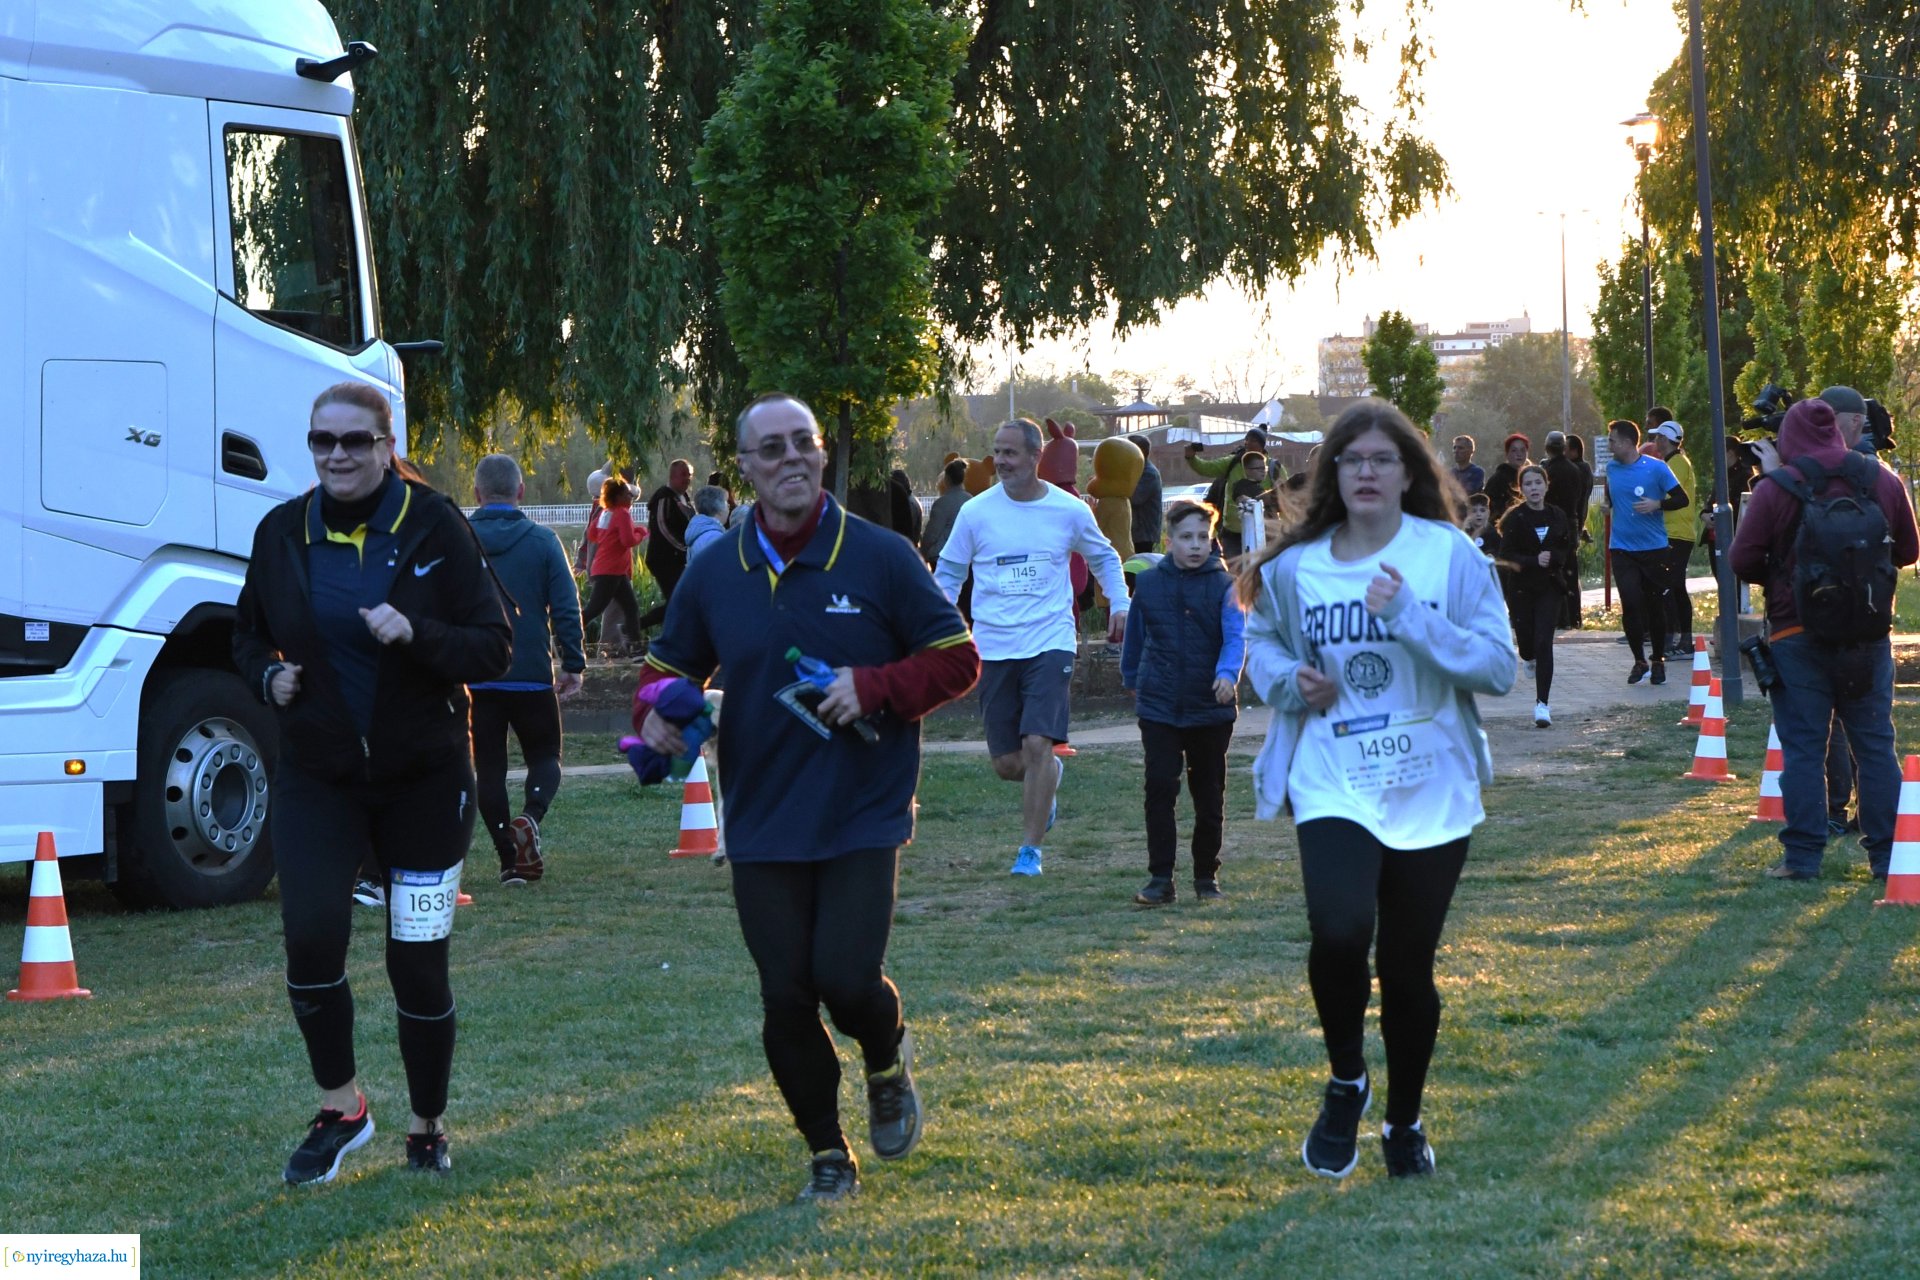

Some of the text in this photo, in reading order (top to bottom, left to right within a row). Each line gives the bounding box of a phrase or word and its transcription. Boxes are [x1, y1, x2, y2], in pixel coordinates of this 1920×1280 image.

[124, 426, 162, 448] XG
[1012, 566, 1037, 579] 1145
[1358, 734, 1412, 760] 1490
[410, 888, 454, 913] 1639
